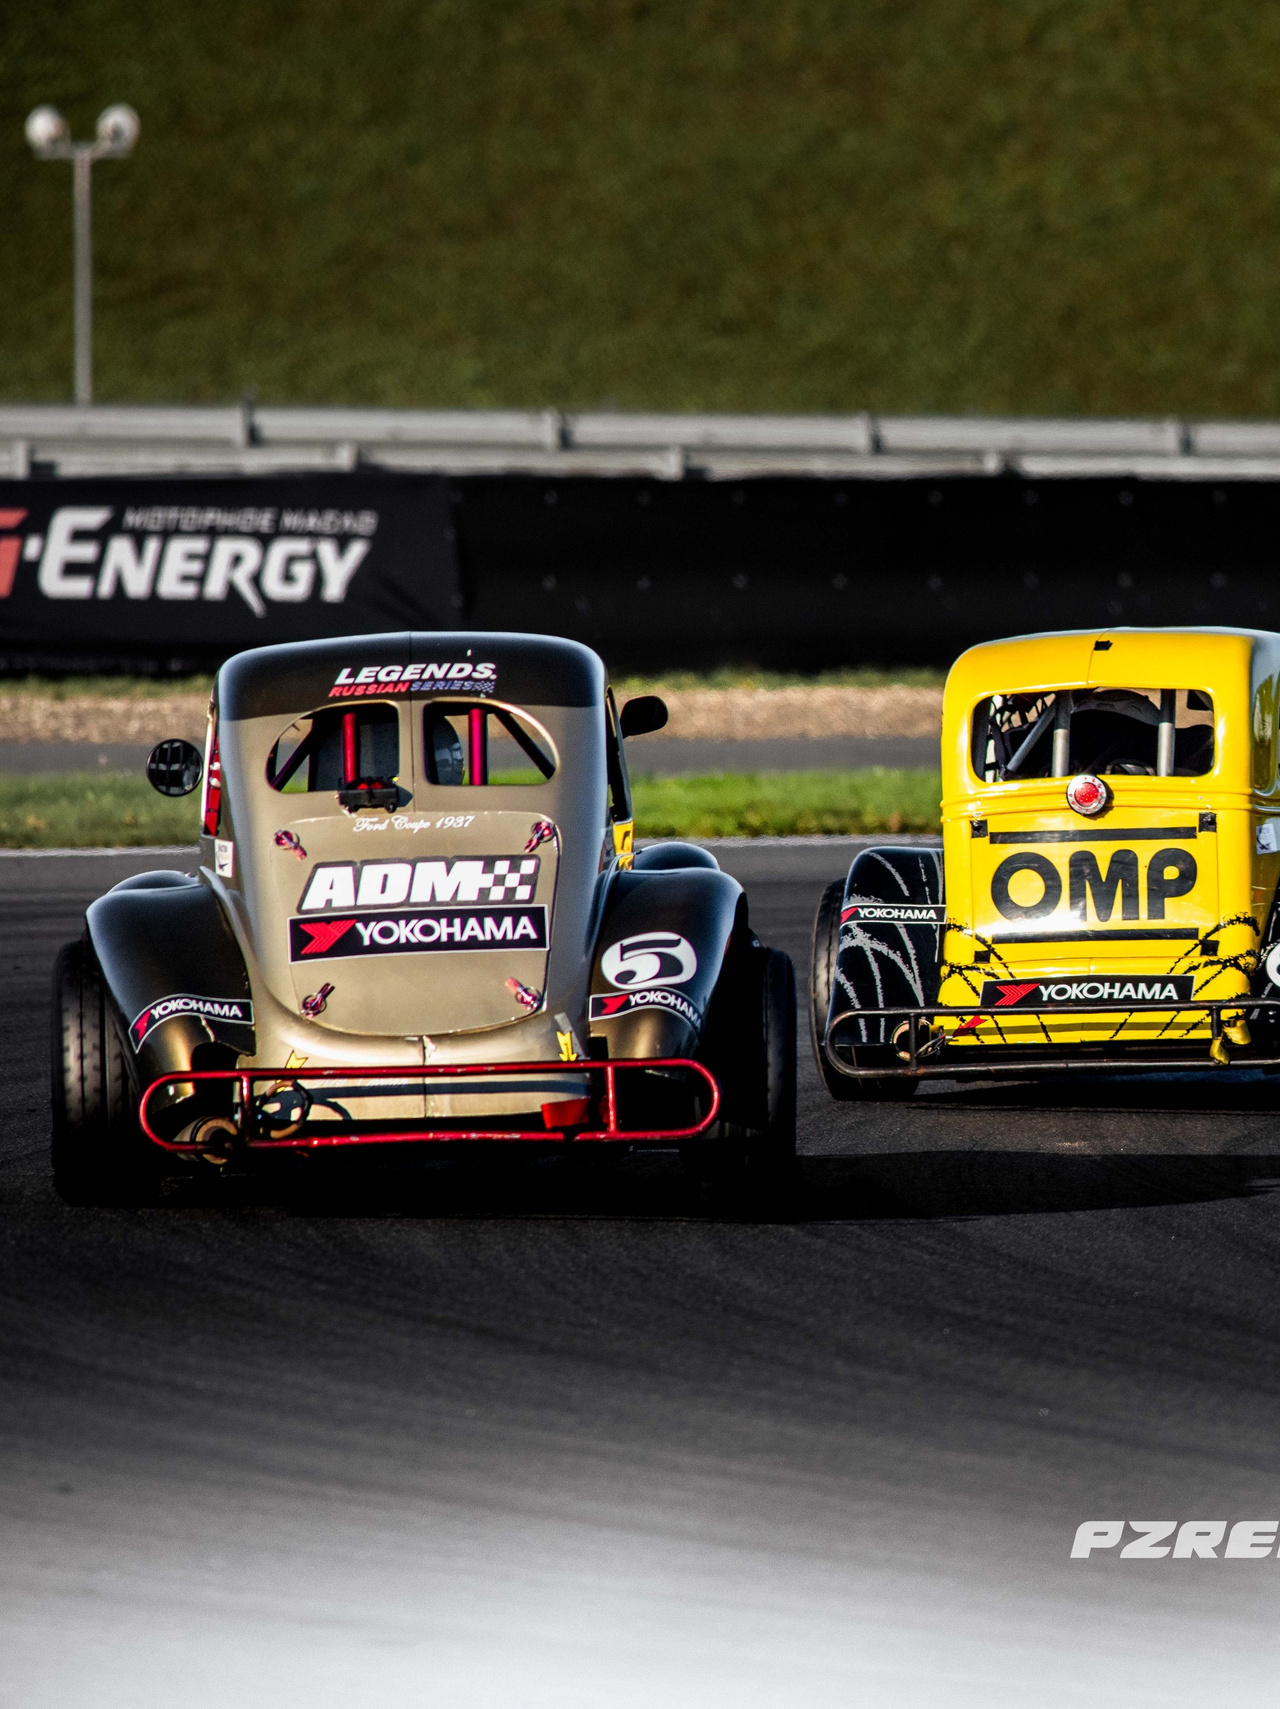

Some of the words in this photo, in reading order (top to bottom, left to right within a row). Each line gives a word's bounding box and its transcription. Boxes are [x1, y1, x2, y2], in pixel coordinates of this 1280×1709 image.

[328, 681, 411, 698] RUSSIAN
[410, 680, 475, 692] SERIES
[352, 817, 390, 832] Ford
[390, 815, 431, 834] Coupe
[435, 815, 475, 829] 1937
[301, 860, 487, 911] ADM
[990, 847, 1198, 924] OMP
[858, 907, 938, 920] YOKOHAMA
[355, 915, 538, 946] YOKOHAMA
[614, 937, 684, 985] 5
[1039, 982, 1179, 1001] YOKOHAMA
[149, 998, 243, 1020] YOKOHAMA
